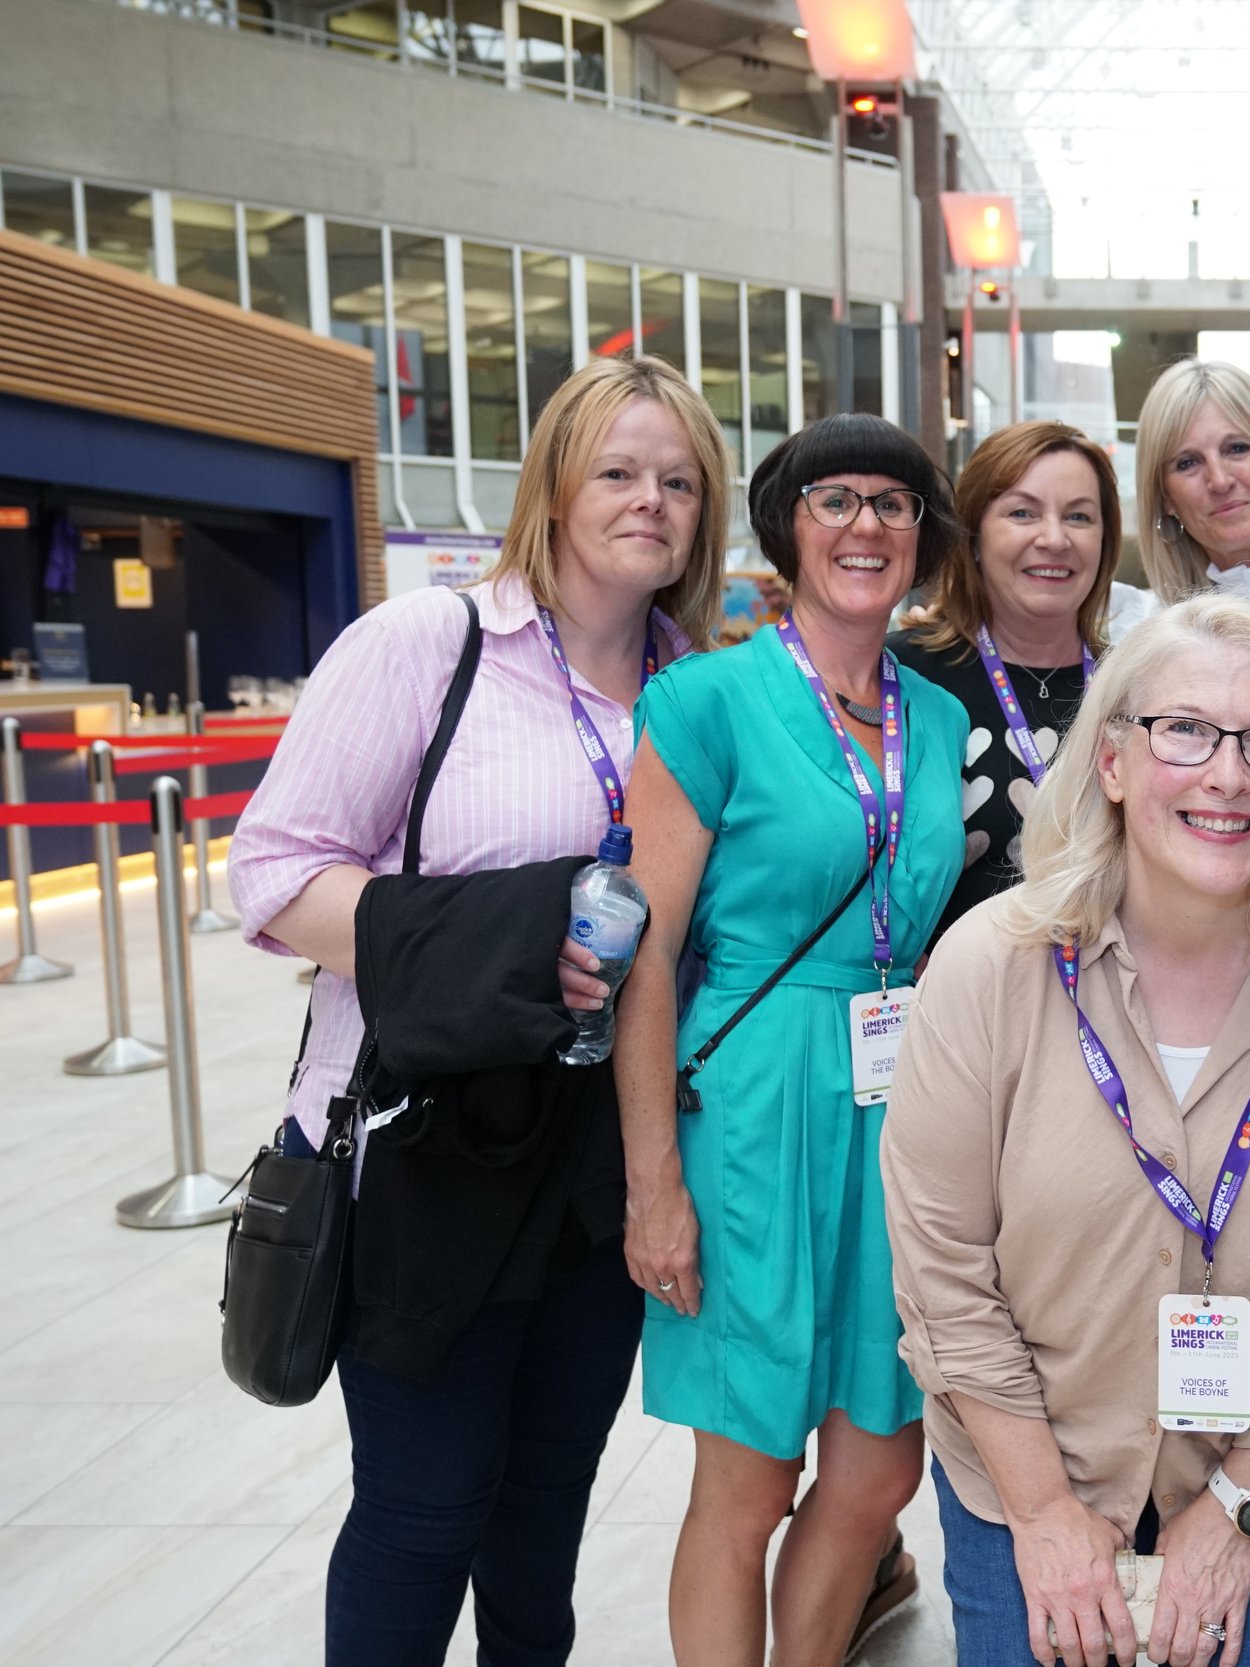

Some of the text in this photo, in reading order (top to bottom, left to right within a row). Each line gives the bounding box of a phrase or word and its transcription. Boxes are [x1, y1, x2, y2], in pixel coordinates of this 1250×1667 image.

[886, 760, 895, 792] LIMERICK
[893, 769, 901, 793] SINGS
[862, 1016, 902, 1030] LIMERICK
[862, 1026, 888, 1038] SINGS
[871, 1067, 884, 1075] THE
[872, 1057, 896, 1067] VOICES
[1081, 1039, 1106, 1085] LIMERICK
[1093, 1051, 1114, 1080] SINGS
[1157, 1180, 1181, 1208] SINGS
[1164, 1175, 1196, 1214] LIMERICK
[1209, 1182, 1231, 1228] LIMERICK
[1214, 1202, 1231, 1232] SINGS
[1171, 1329, 1225, 1340] LIMERICK
[1171, 1338, 1205, 1349] SINGS
[1180, 1386, 1229, 1397] THE BOYNE
[1182, 1378, 1228, 1387] VOICES OF
